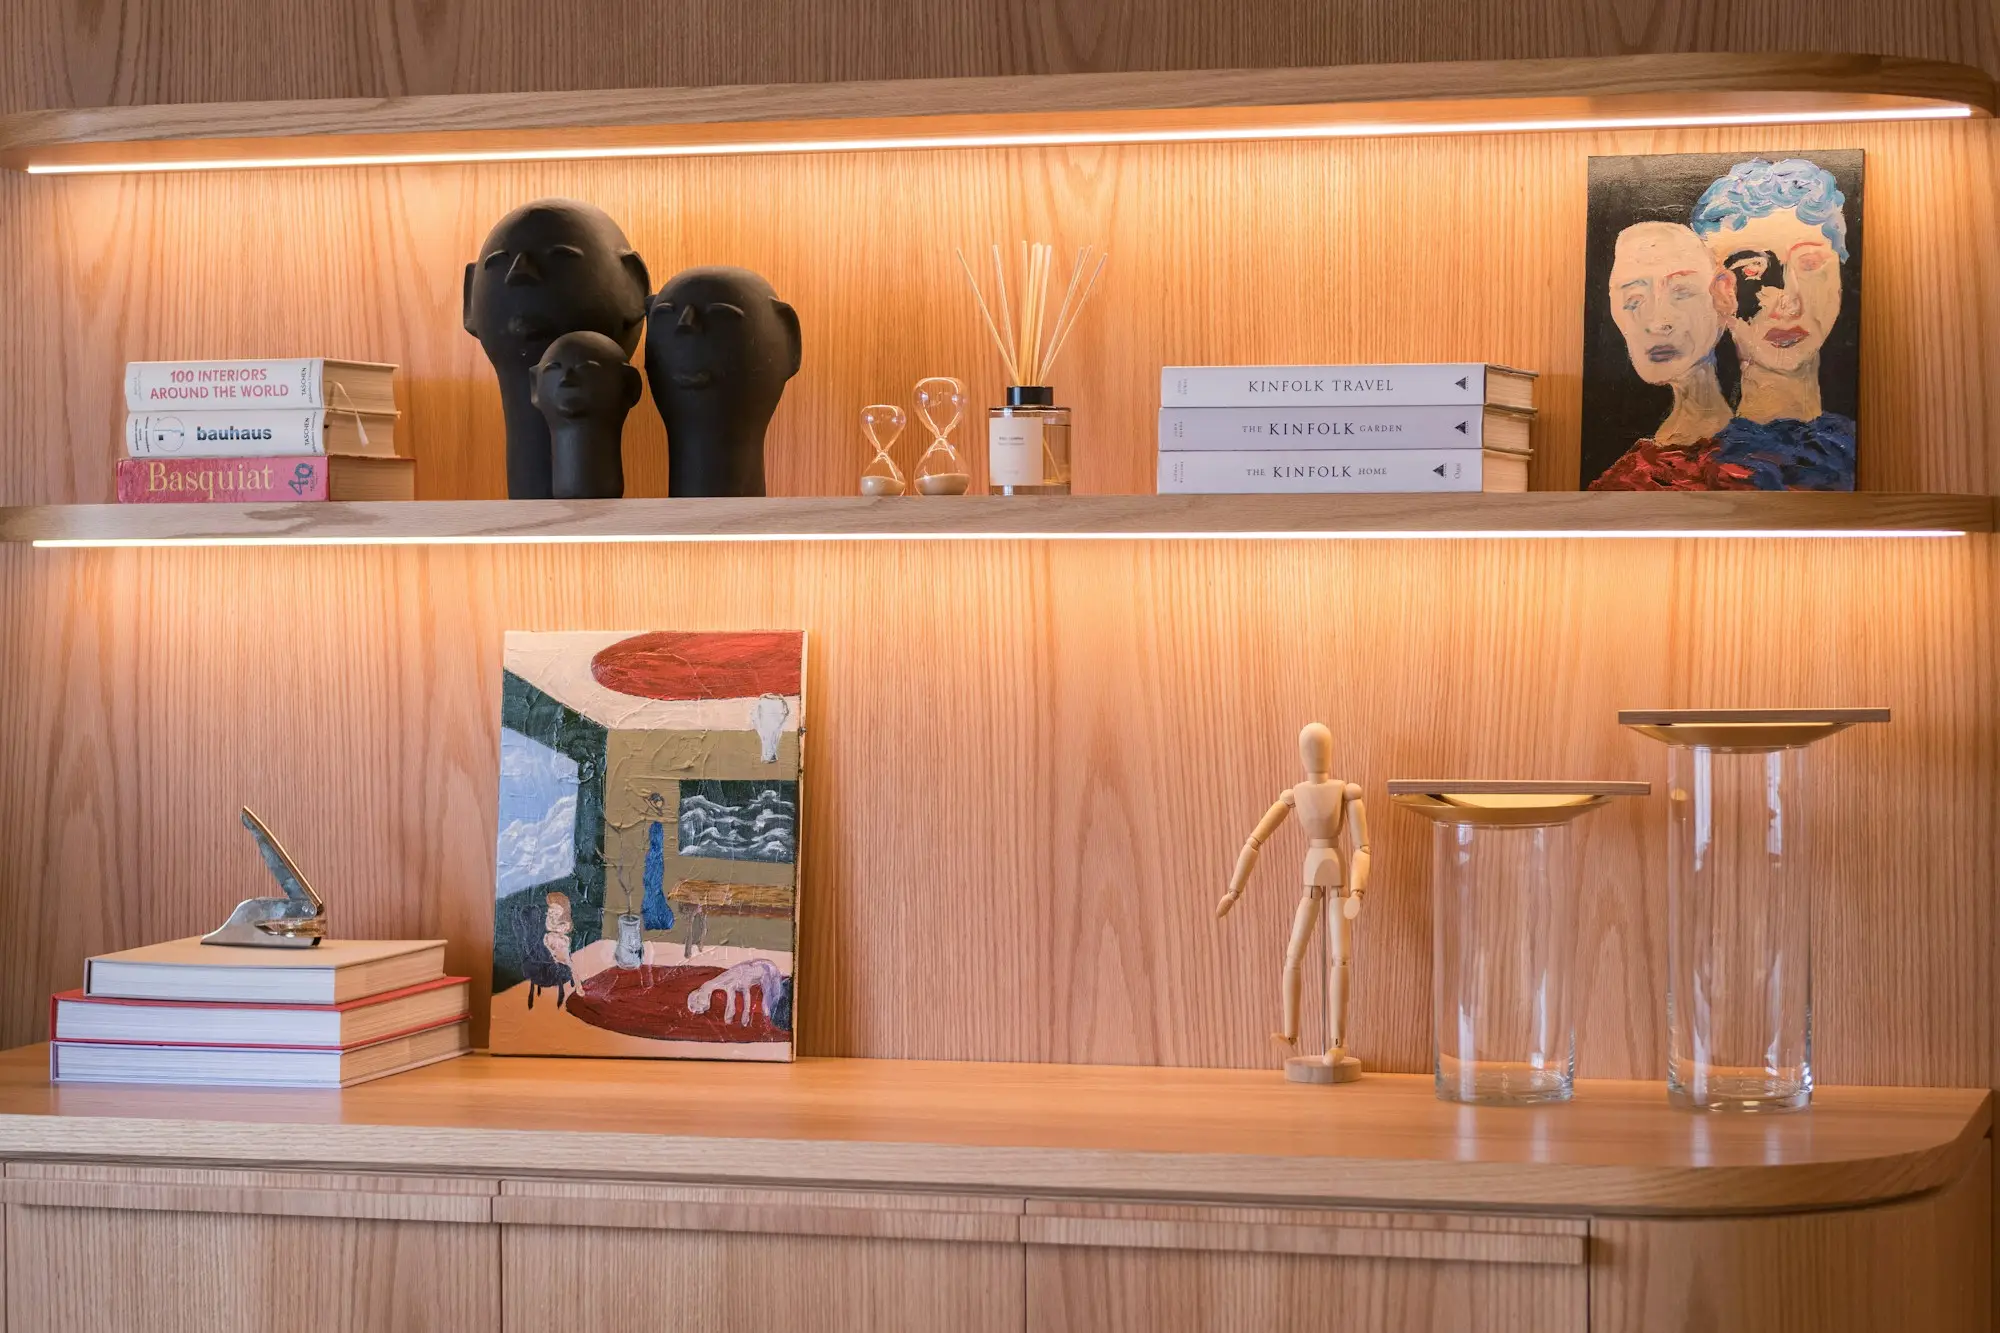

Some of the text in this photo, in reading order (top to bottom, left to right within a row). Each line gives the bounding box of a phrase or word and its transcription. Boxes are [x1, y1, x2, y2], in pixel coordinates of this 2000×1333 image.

[170, 368, 267, 383] 100 INTERIORS
[150, 384, 289, 399] AROUND THE WORLD
[1249, 379, 1394, 392] KINFOLK TRAVEL
[197, 426, 272, 440] bauhaus
[1242, 422, 1403, 435] THE KINFOLK GARDEN
[1247, 466, 1387, 478] THE KINFOLK HOME
[148, 461, 274, 500] Basquiat
